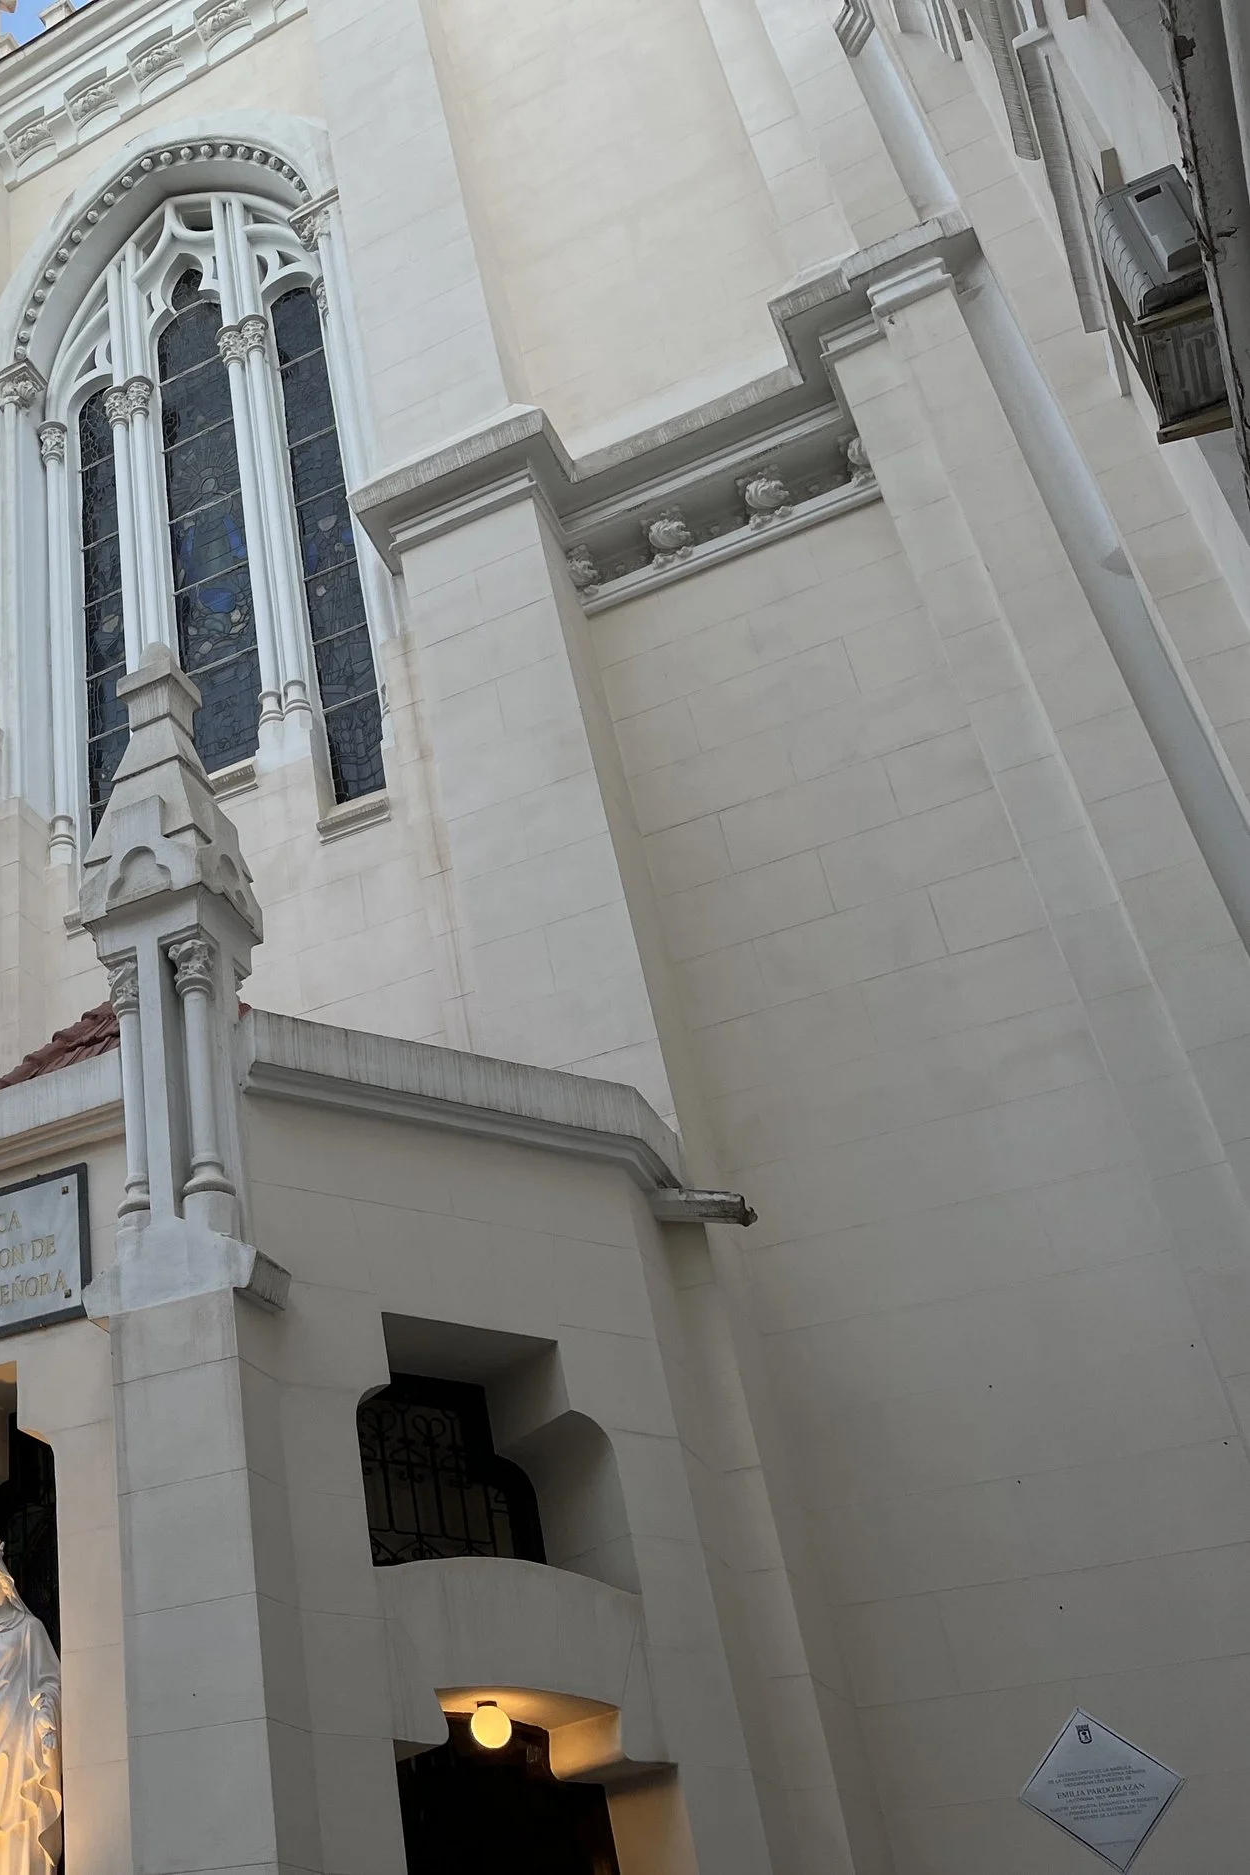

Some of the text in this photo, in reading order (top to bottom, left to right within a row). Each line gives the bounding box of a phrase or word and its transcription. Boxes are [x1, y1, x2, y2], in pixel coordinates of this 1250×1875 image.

[30, 1234, 57, 1261] DE
[1056, 1789, 1087, 1800] EMILIA
[1087, 1785, 1115, 1796] PARDO
